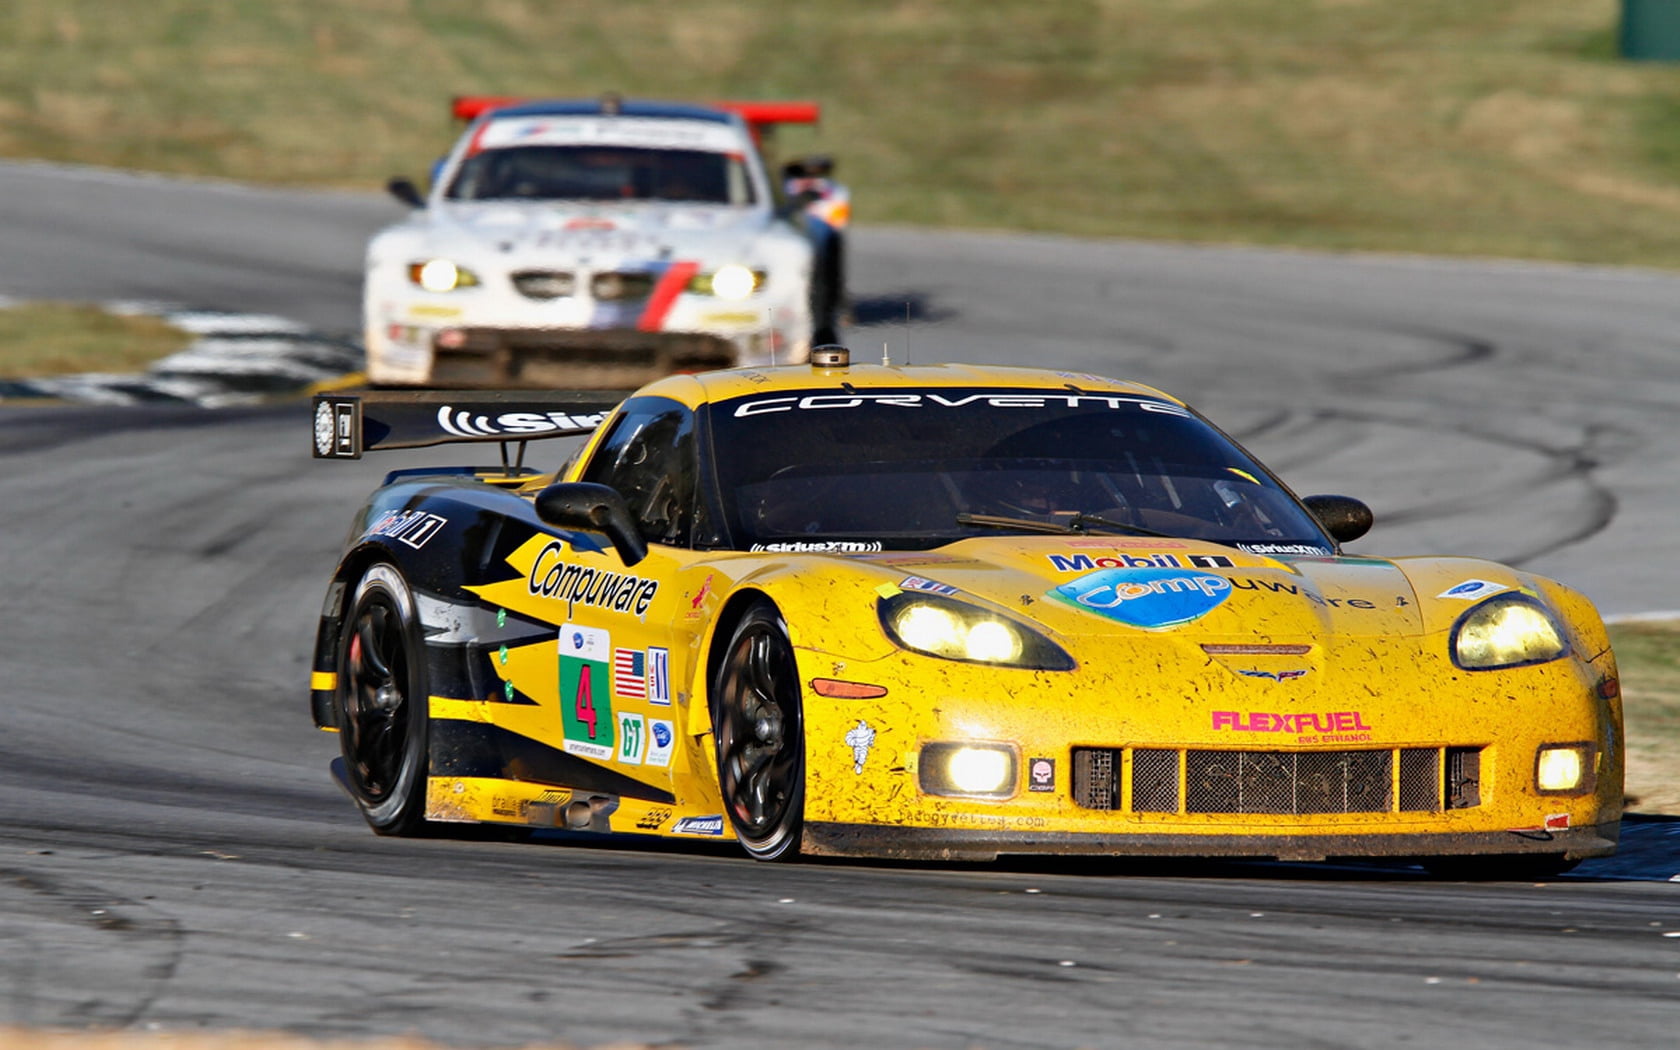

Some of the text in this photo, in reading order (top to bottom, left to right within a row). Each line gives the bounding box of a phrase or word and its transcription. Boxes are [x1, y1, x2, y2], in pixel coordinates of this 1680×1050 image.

[733, 393, 1190, 418] CORVETTE
[1046, 554, 1182, 572] Mobil
[528, 540, 659, 620] Compuware
[575, 663, 598, 741] 4
[1211, 711, 1372, 734] FLEXFUEL
[622, 717, 642, 758] GT
[1322, 732, 1372, 744] ETHANOL
